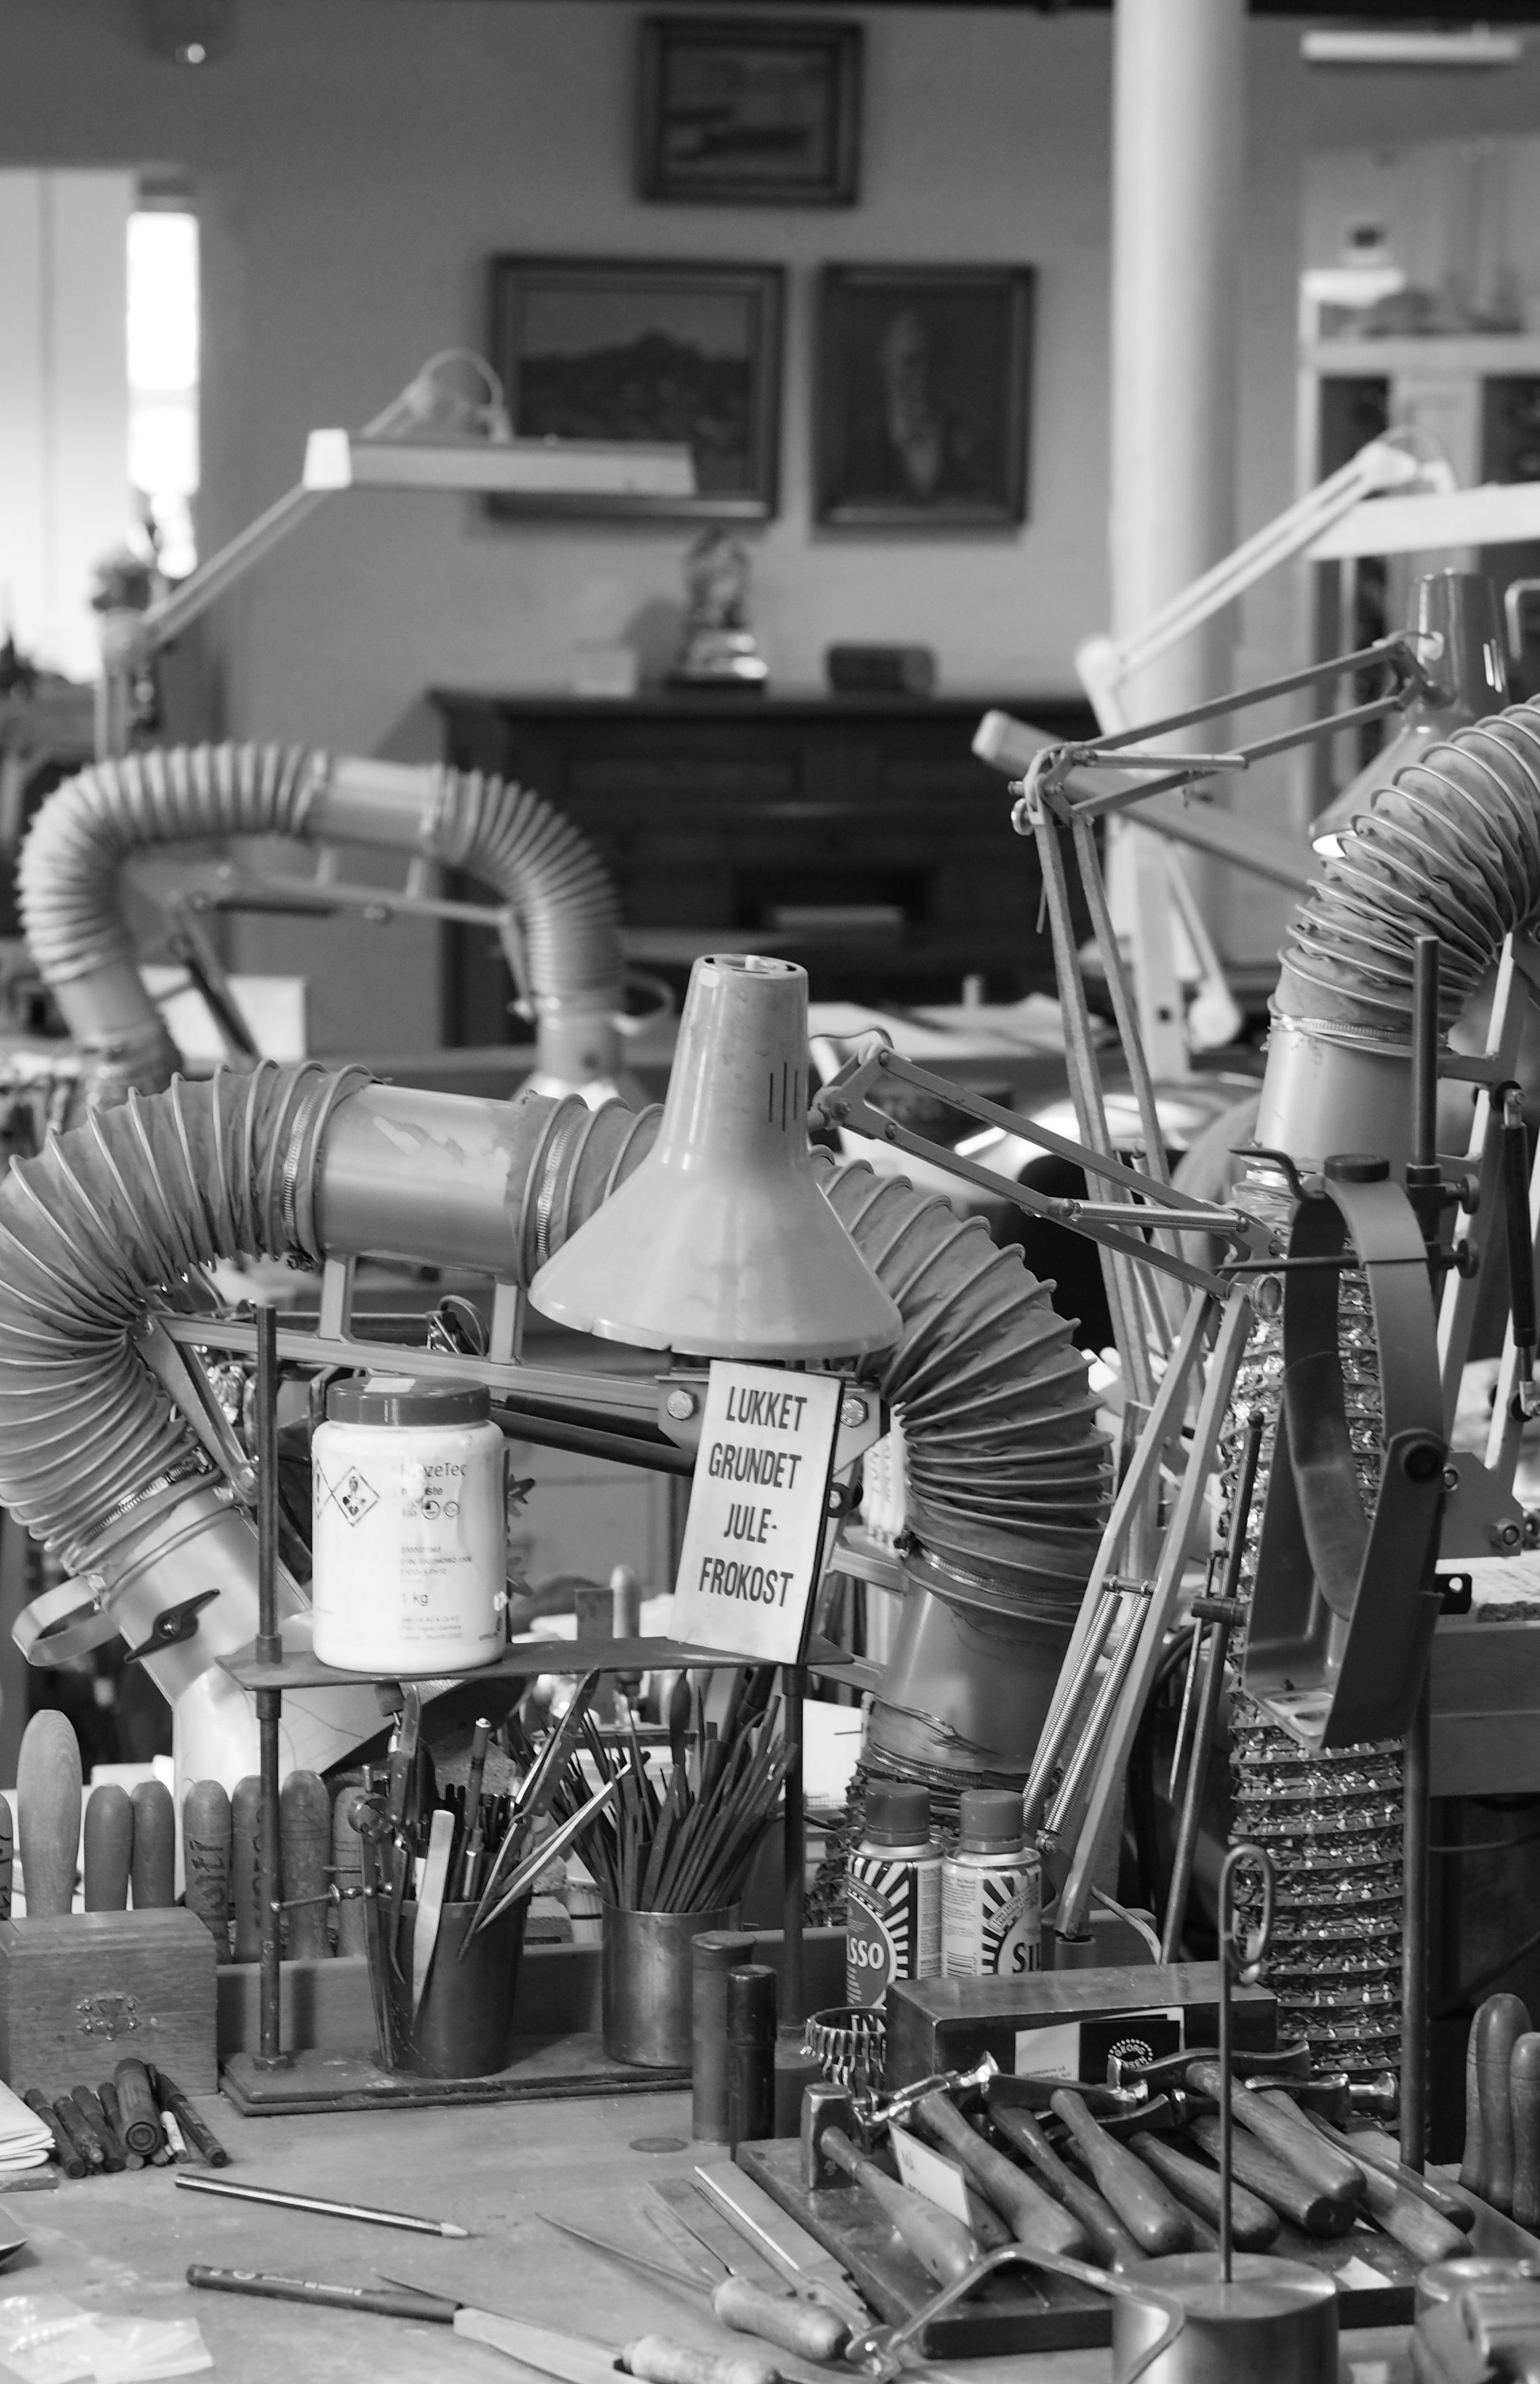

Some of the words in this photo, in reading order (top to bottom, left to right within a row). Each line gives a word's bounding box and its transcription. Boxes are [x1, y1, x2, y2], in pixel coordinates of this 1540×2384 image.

[726, 1386, 808, 1432] LUKKET
[708, 1442, 801, 1490] GRUNDET
[723, 1503, 777, 1544] JULE-
[413, 1591, 429, 1607] kg
[699, 1557, 794, 1607] FROKOST
[1114, 2043, 1146, 2058] GEORG
